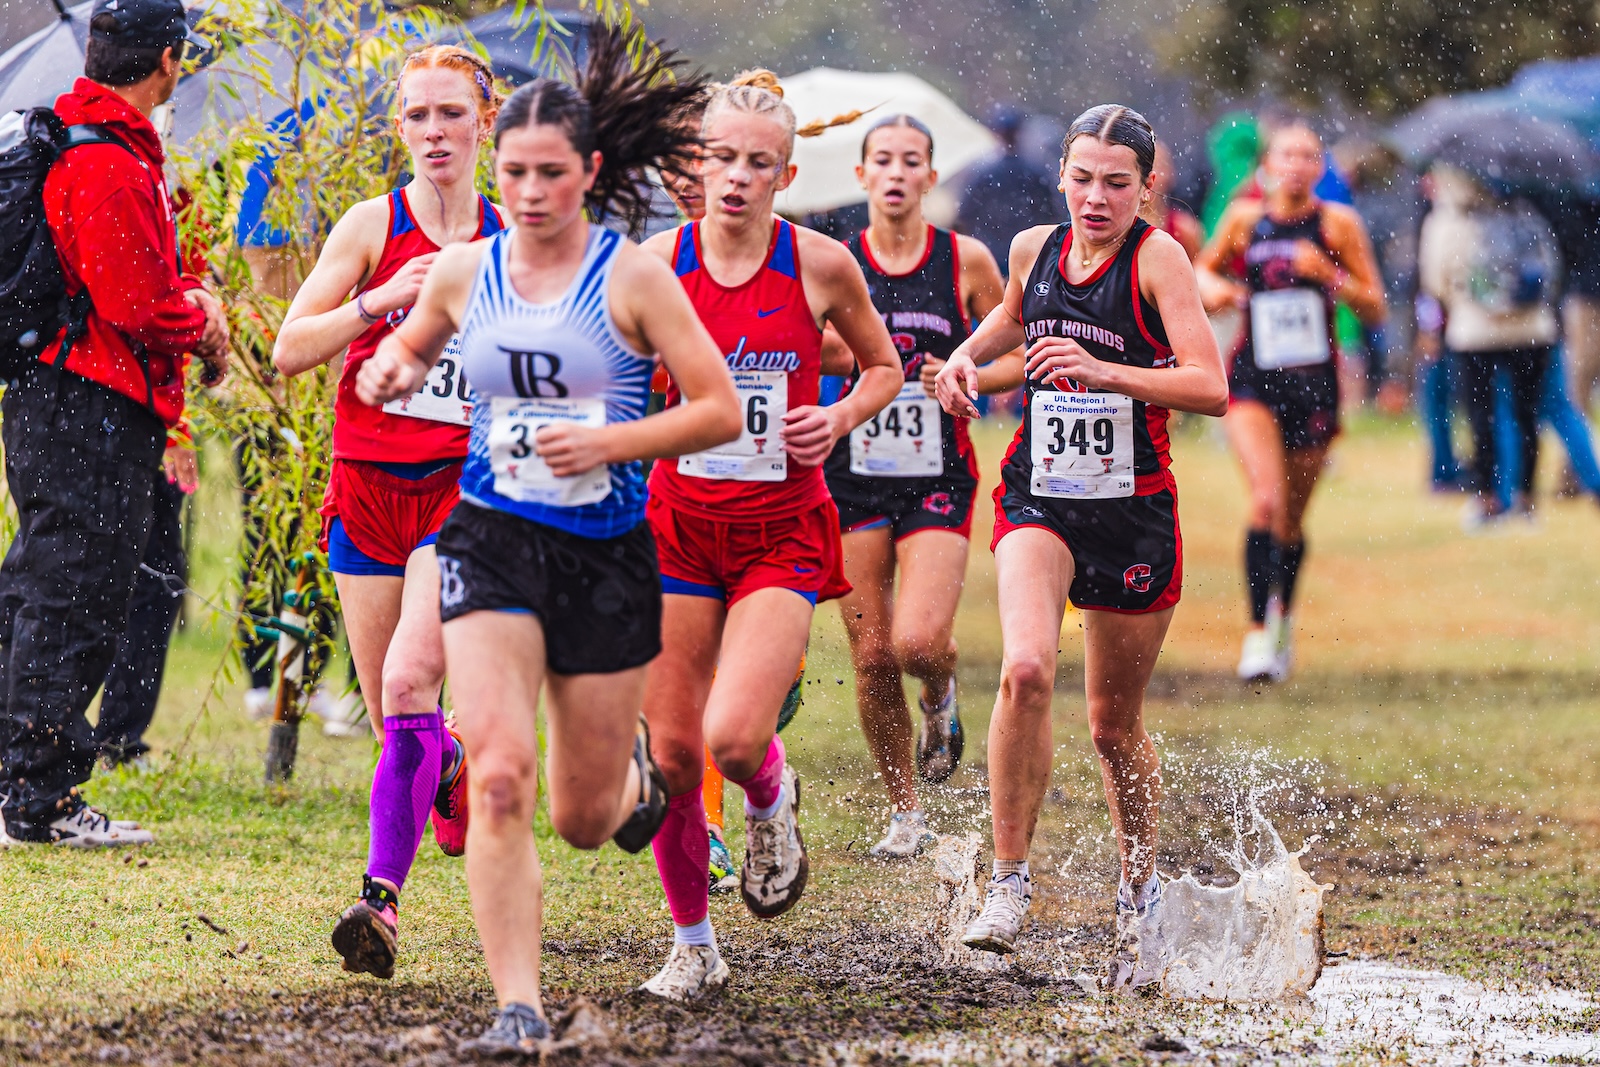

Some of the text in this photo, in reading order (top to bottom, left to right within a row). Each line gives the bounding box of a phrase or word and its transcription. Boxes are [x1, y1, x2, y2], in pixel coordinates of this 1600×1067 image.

[1024, 319, 1125, 352] LADY HOUNDS
[725, 336, 801, 373] down
[735, 383, 774, 391] ionship
[1043, 404, 1118, 415] XC Championship
[1054, 395, 1068, 403] UIL
[1070, 396, 1100, 405] Region
[865, 405, 923, 438] 343
[1047, 416, 1114, 455] 349
[1118, 481, 1131, 489] 349
